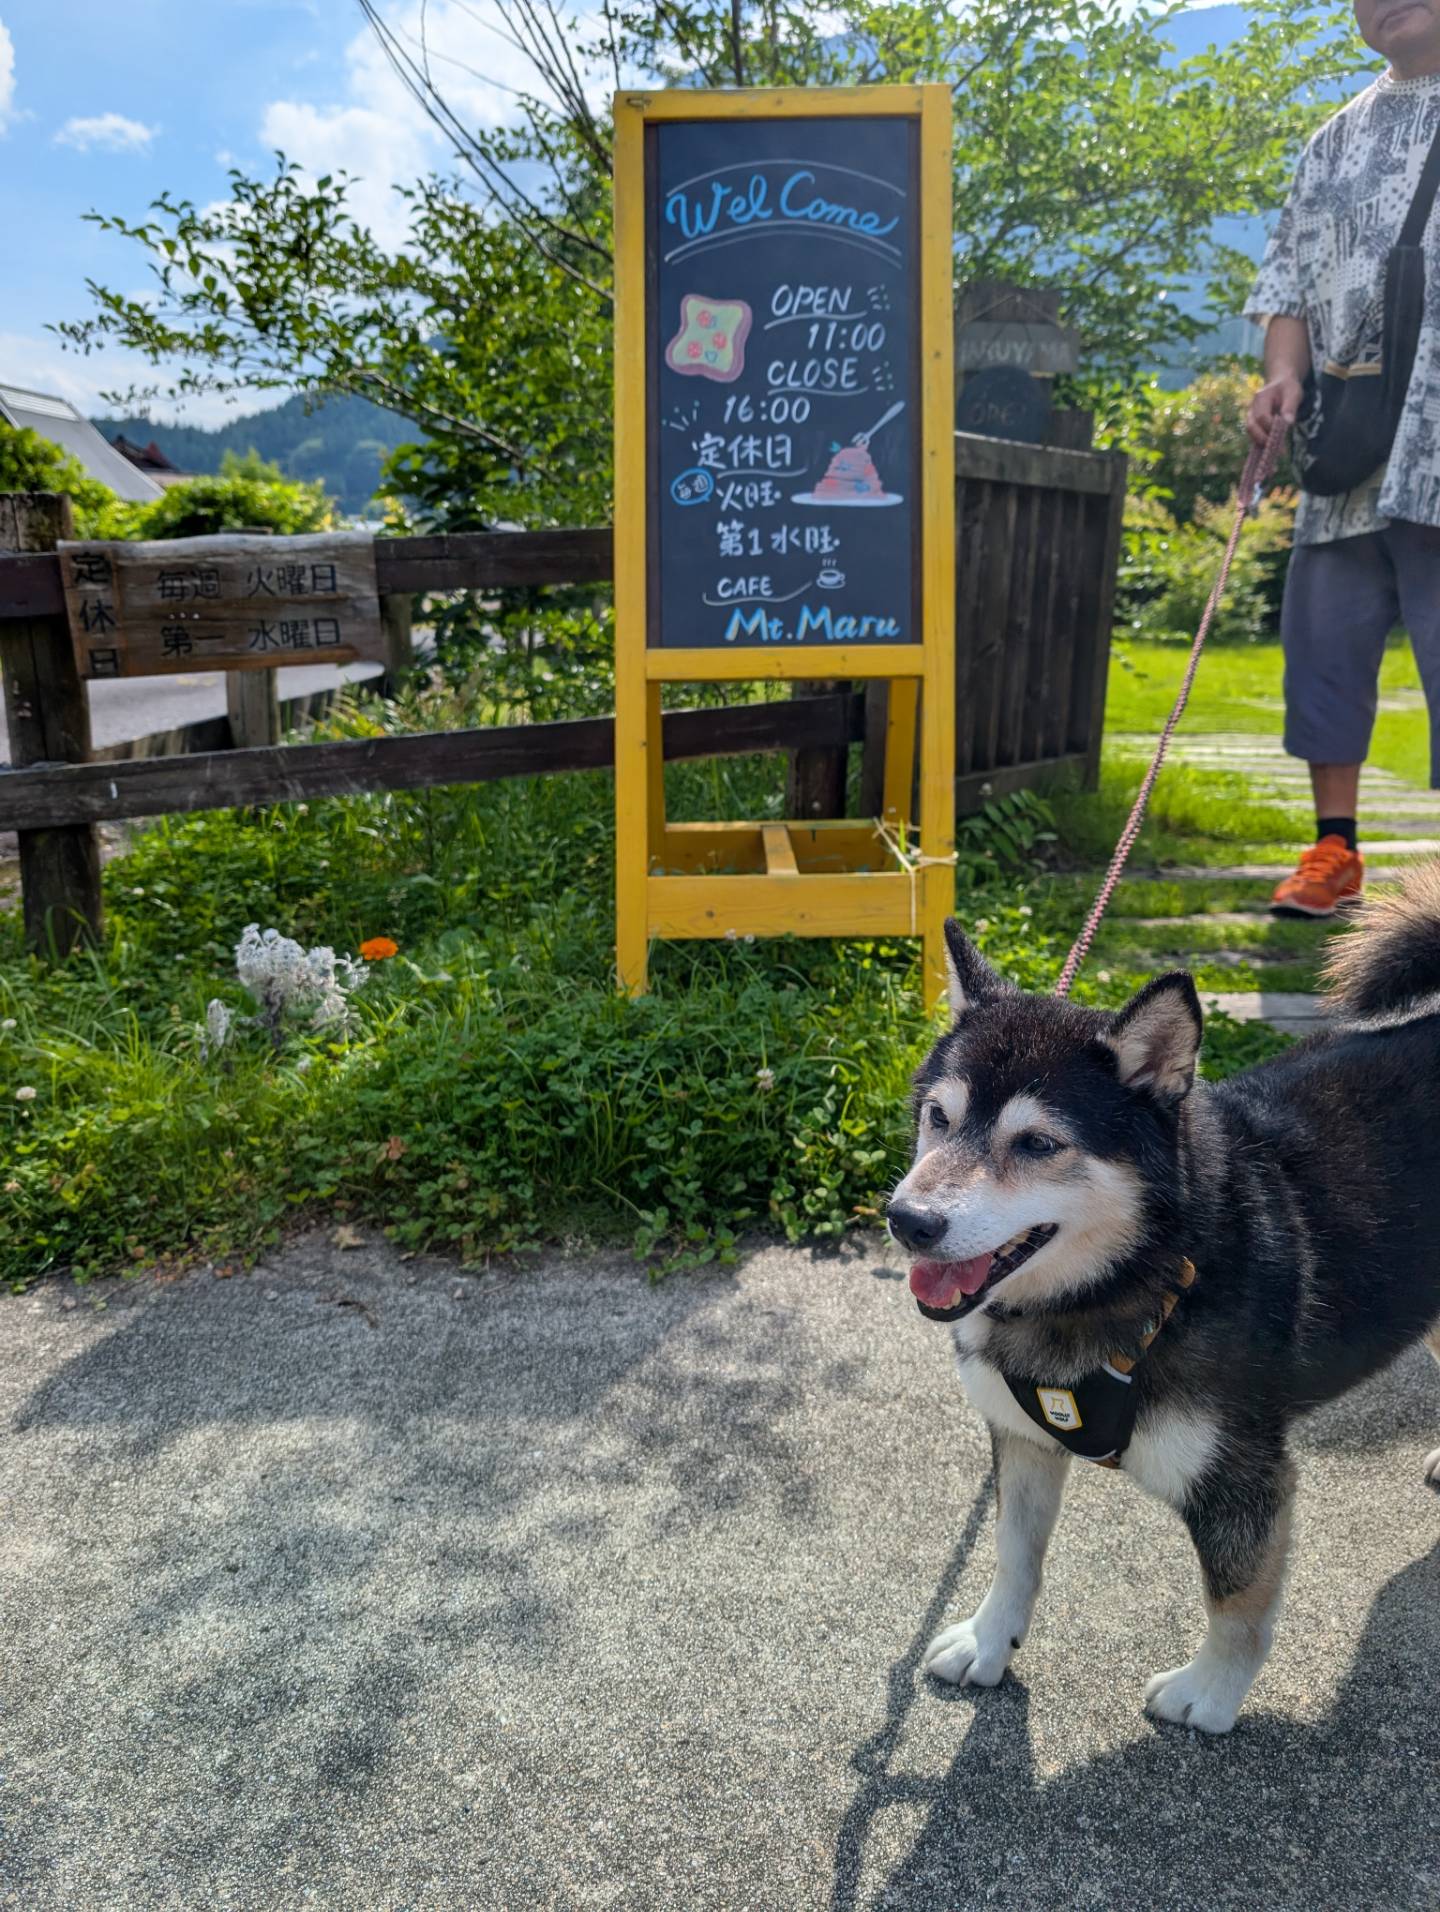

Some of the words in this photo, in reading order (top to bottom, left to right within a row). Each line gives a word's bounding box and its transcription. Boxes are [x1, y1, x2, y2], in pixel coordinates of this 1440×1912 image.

[771, 284, 852, 316] OPEN
[808, 321, 885, 351] 11:00
[768, 357, 858, 388] CLOSE
[724, 395, 811, 424] 16:00
[692, 432, 792, 470] 定休日
[157, 568, 222, 601] 毎週
[247, 563, 337, 598] 火曜日
[717, 576, 773, 598] CAFE
[71, 551, 119, 677] 定休日
[161, 624, 225, 657] 第一
[248, 617, 340, 650] 水曜日
